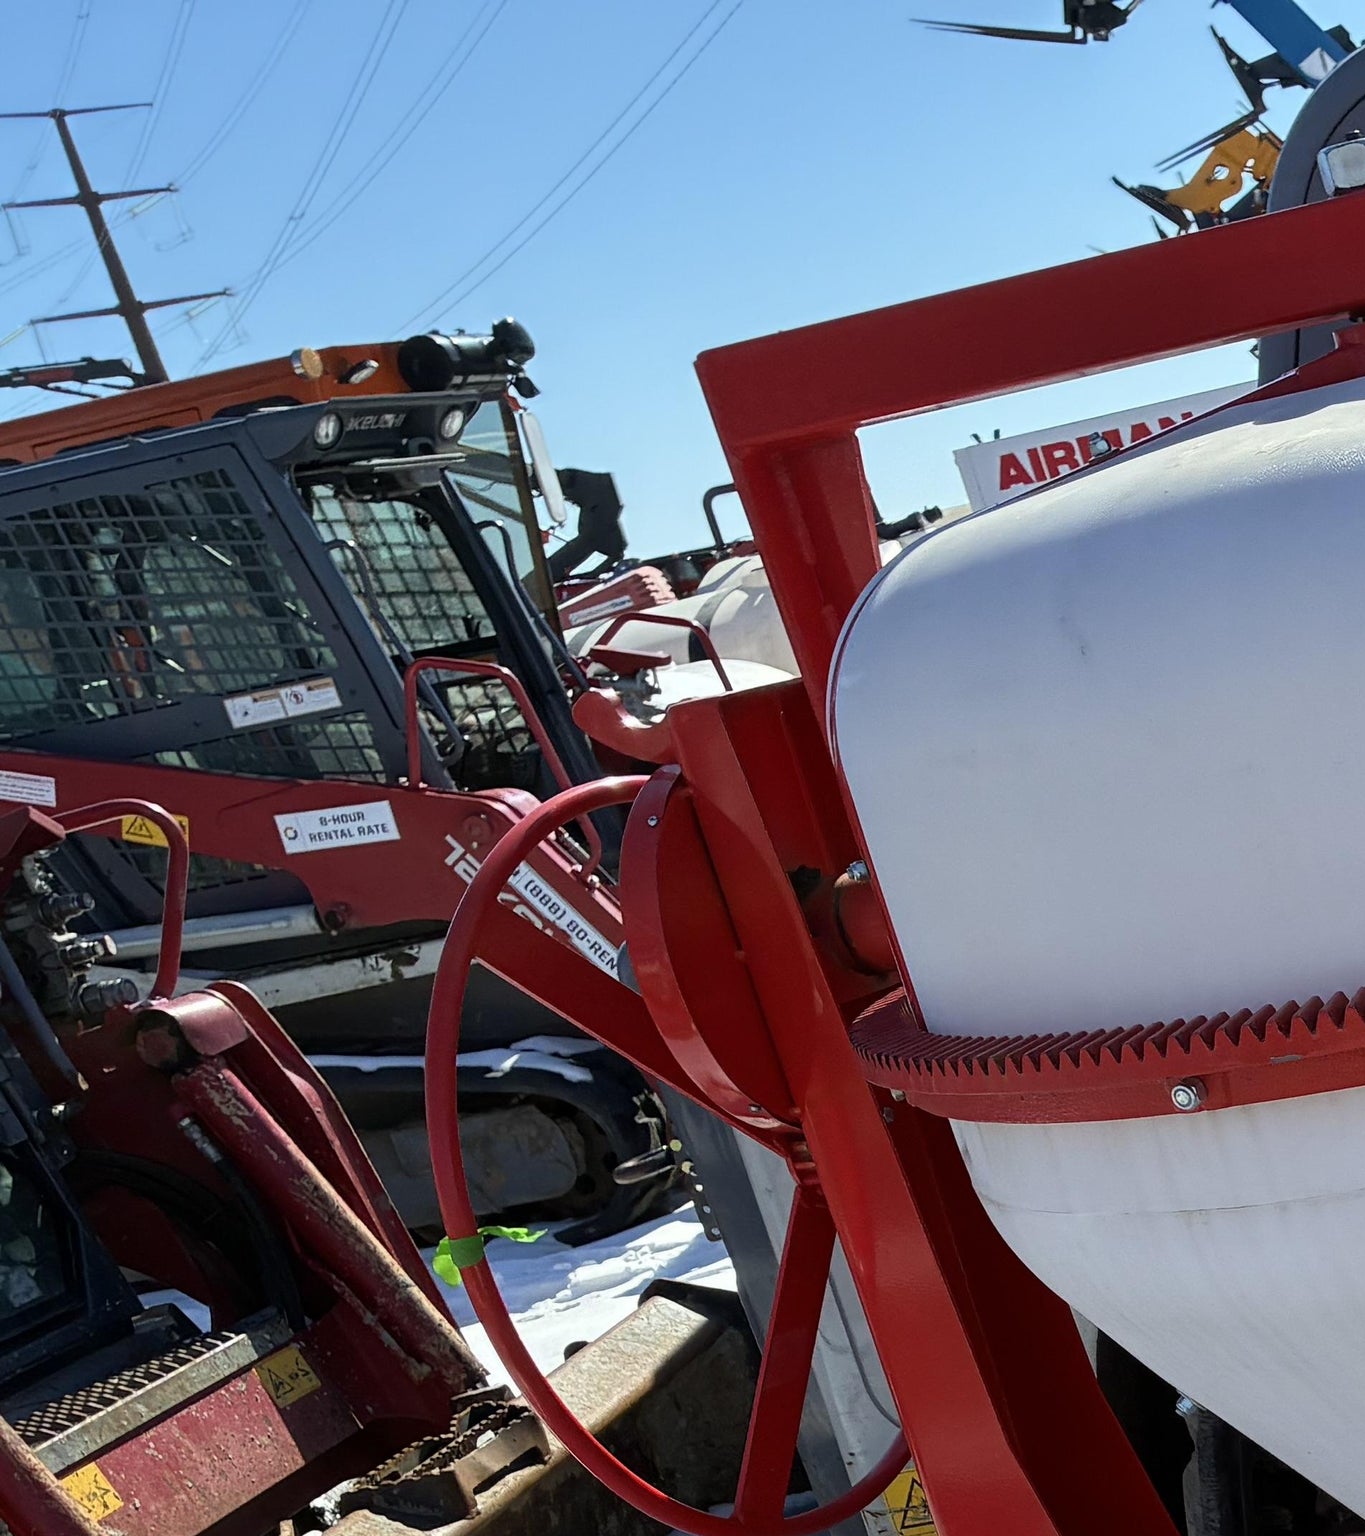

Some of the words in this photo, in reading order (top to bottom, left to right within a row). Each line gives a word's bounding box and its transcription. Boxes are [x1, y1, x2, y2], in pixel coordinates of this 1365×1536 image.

[319, 811, 365, 827] 8-HOUR
[308, 827, 355, 843] RENTAL
[357, 822, 390, 838] RATE
[524, 879, 567, 921] (888)
